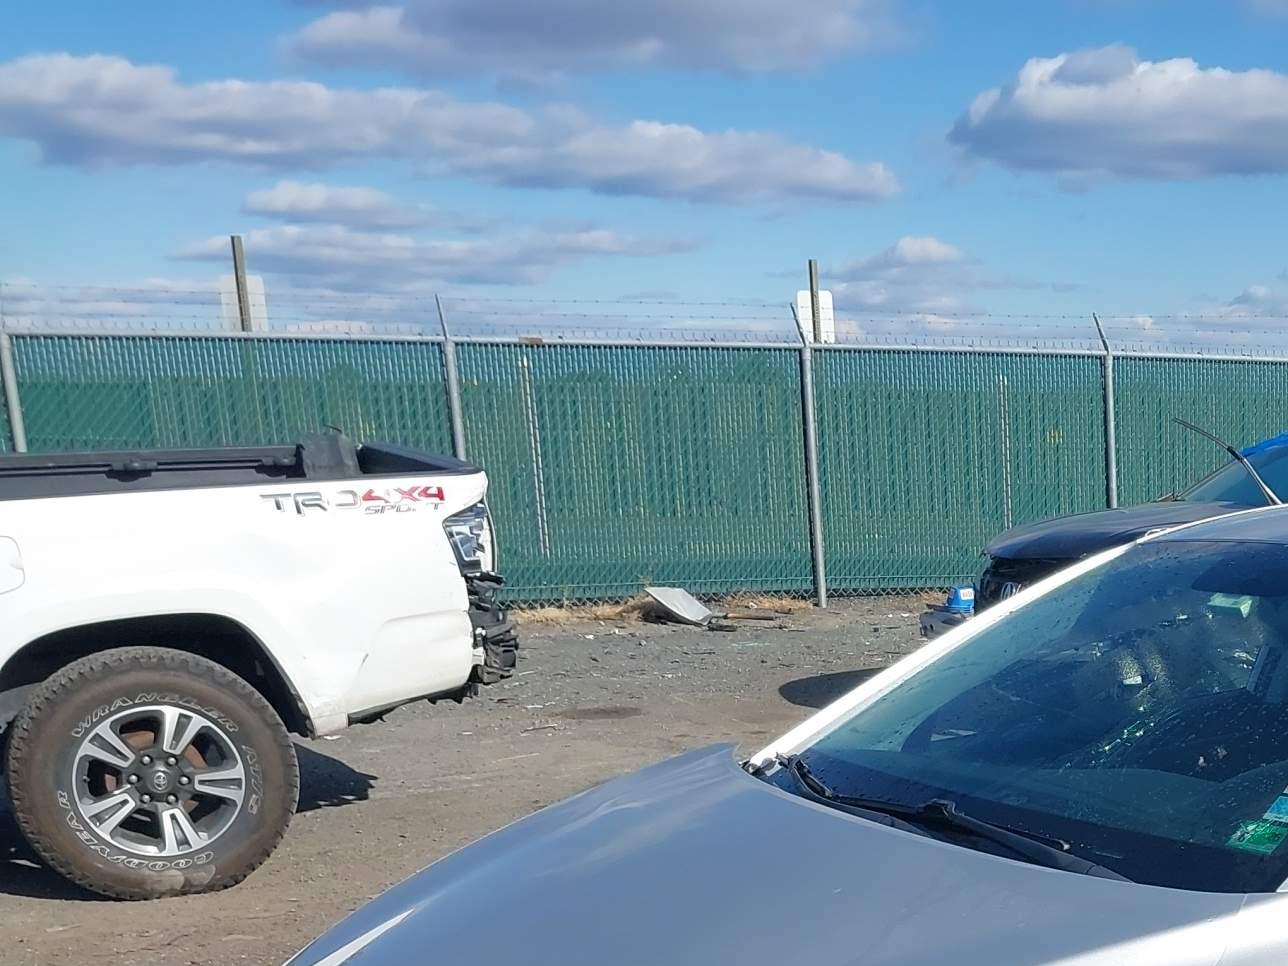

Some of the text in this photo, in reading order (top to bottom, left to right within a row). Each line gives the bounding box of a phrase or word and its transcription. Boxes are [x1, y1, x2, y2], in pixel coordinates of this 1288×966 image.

[259, 490, 361, 515] TRD
[71, 692, 240, 737] WRANGLER
[57, 790, 214, 871] GOODYEAR
